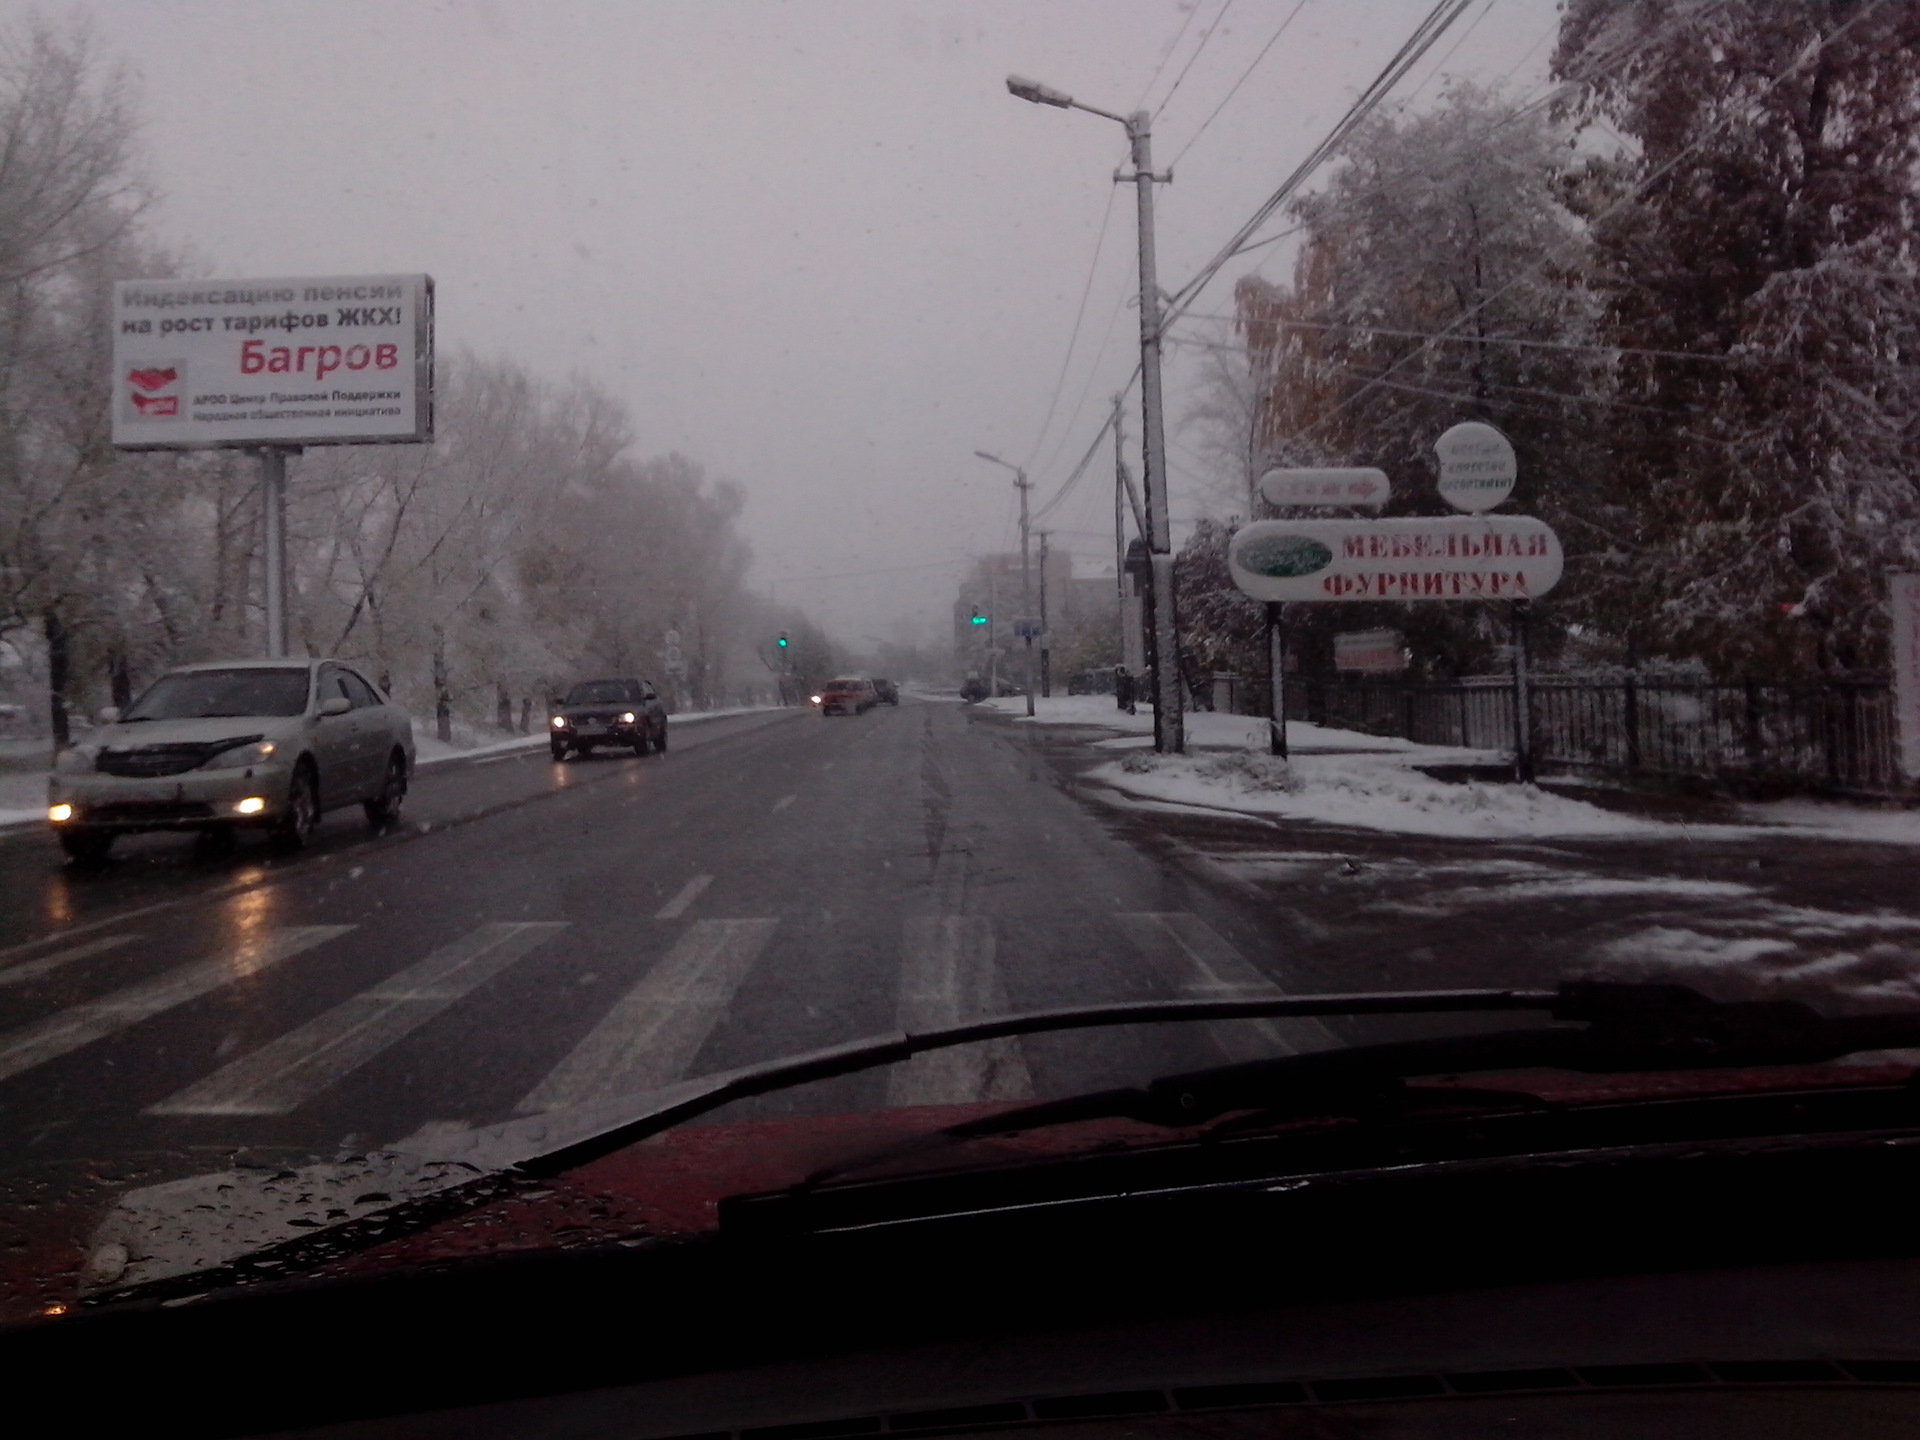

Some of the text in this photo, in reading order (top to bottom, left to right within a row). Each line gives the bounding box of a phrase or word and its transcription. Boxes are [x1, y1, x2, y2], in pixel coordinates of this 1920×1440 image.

[122, 282, 402, 310] Индексацию пенсии
[121, 307, 402, 338] на рост тарифов ЖКХ!
[241, 340, 399, 380] Багров
[332, 390, 401, 402] Поддержки
[334, 407, 401, 418] инициатива
[1343, 532, 1548, 558] МЕБЕЛЬНАЯ
[1323, 571, 1530, 596] ФУРНИТУРА
